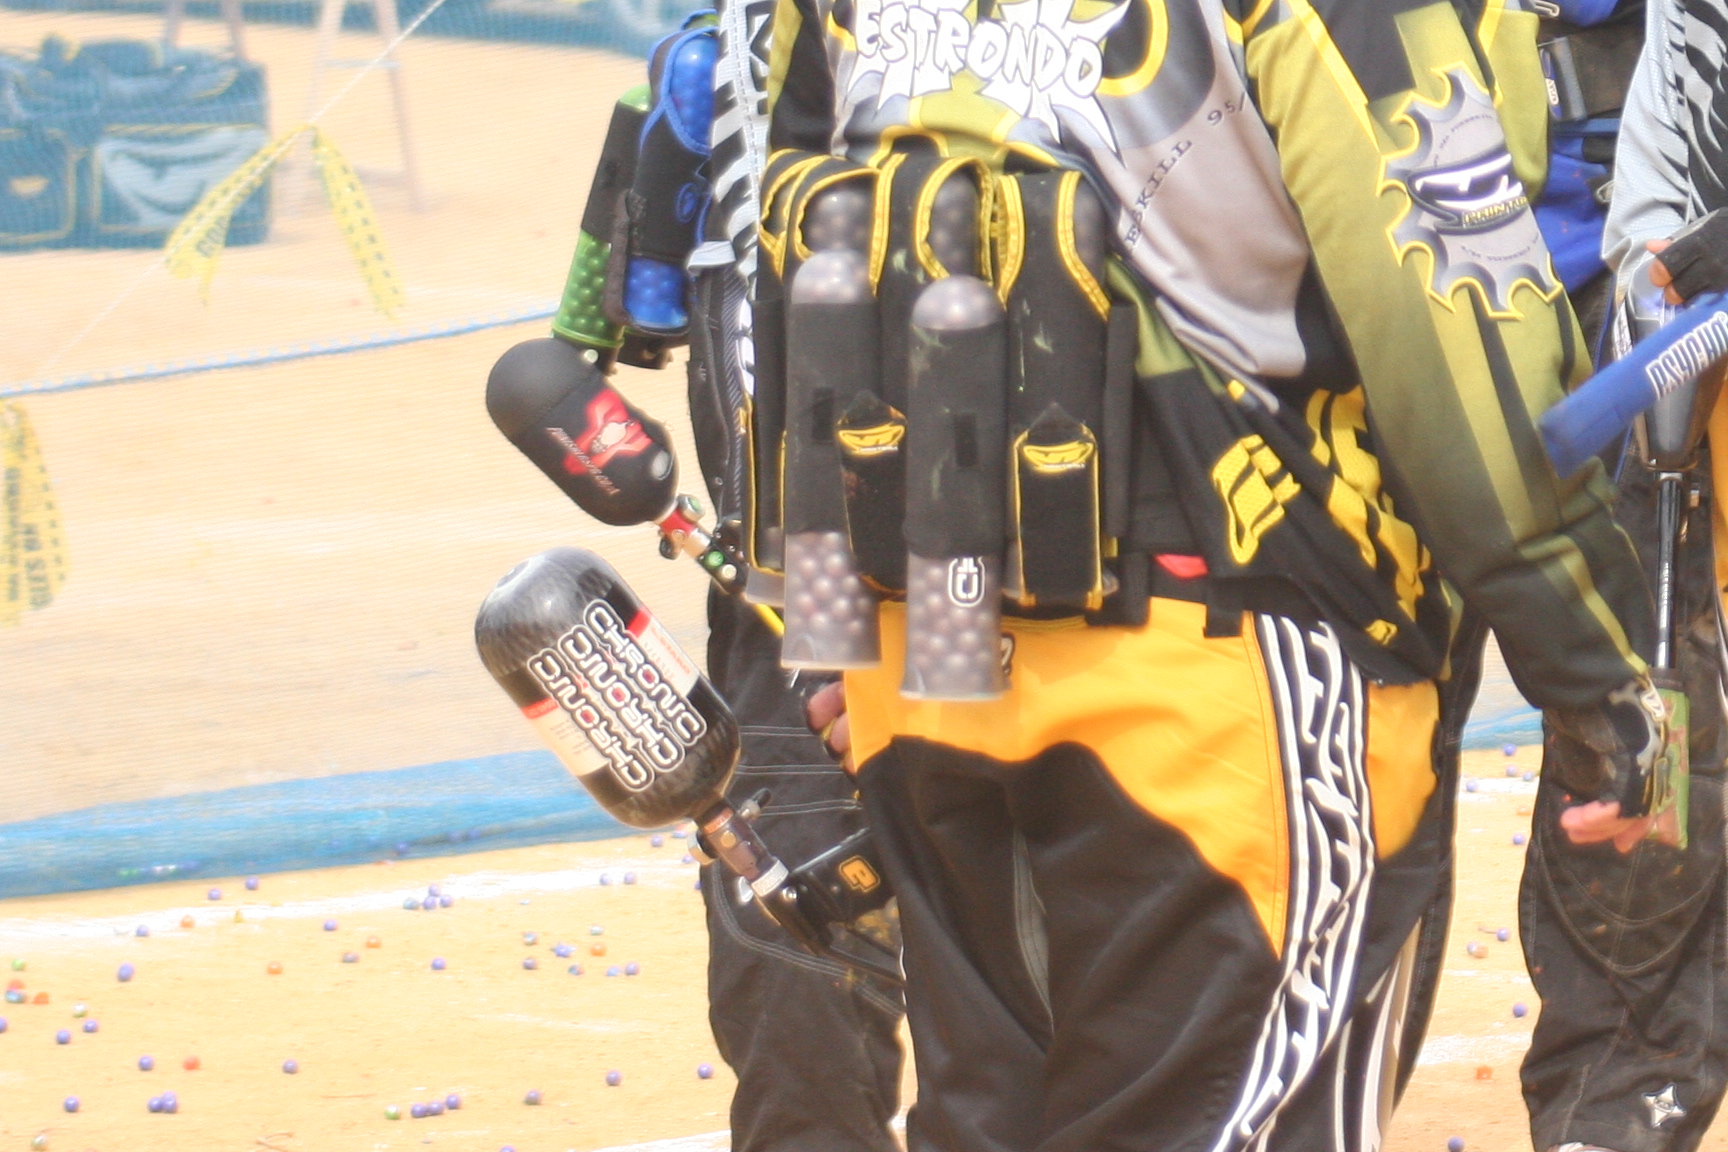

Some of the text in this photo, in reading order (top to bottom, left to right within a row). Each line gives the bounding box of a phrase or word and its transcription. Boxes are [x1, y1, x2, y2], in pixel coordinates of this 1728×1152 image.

[534, 654, 648, 786] CHRONIC
[565, 631, 679, 765] CHRONIC
[589, 606, 701, 740] CHRONIC
